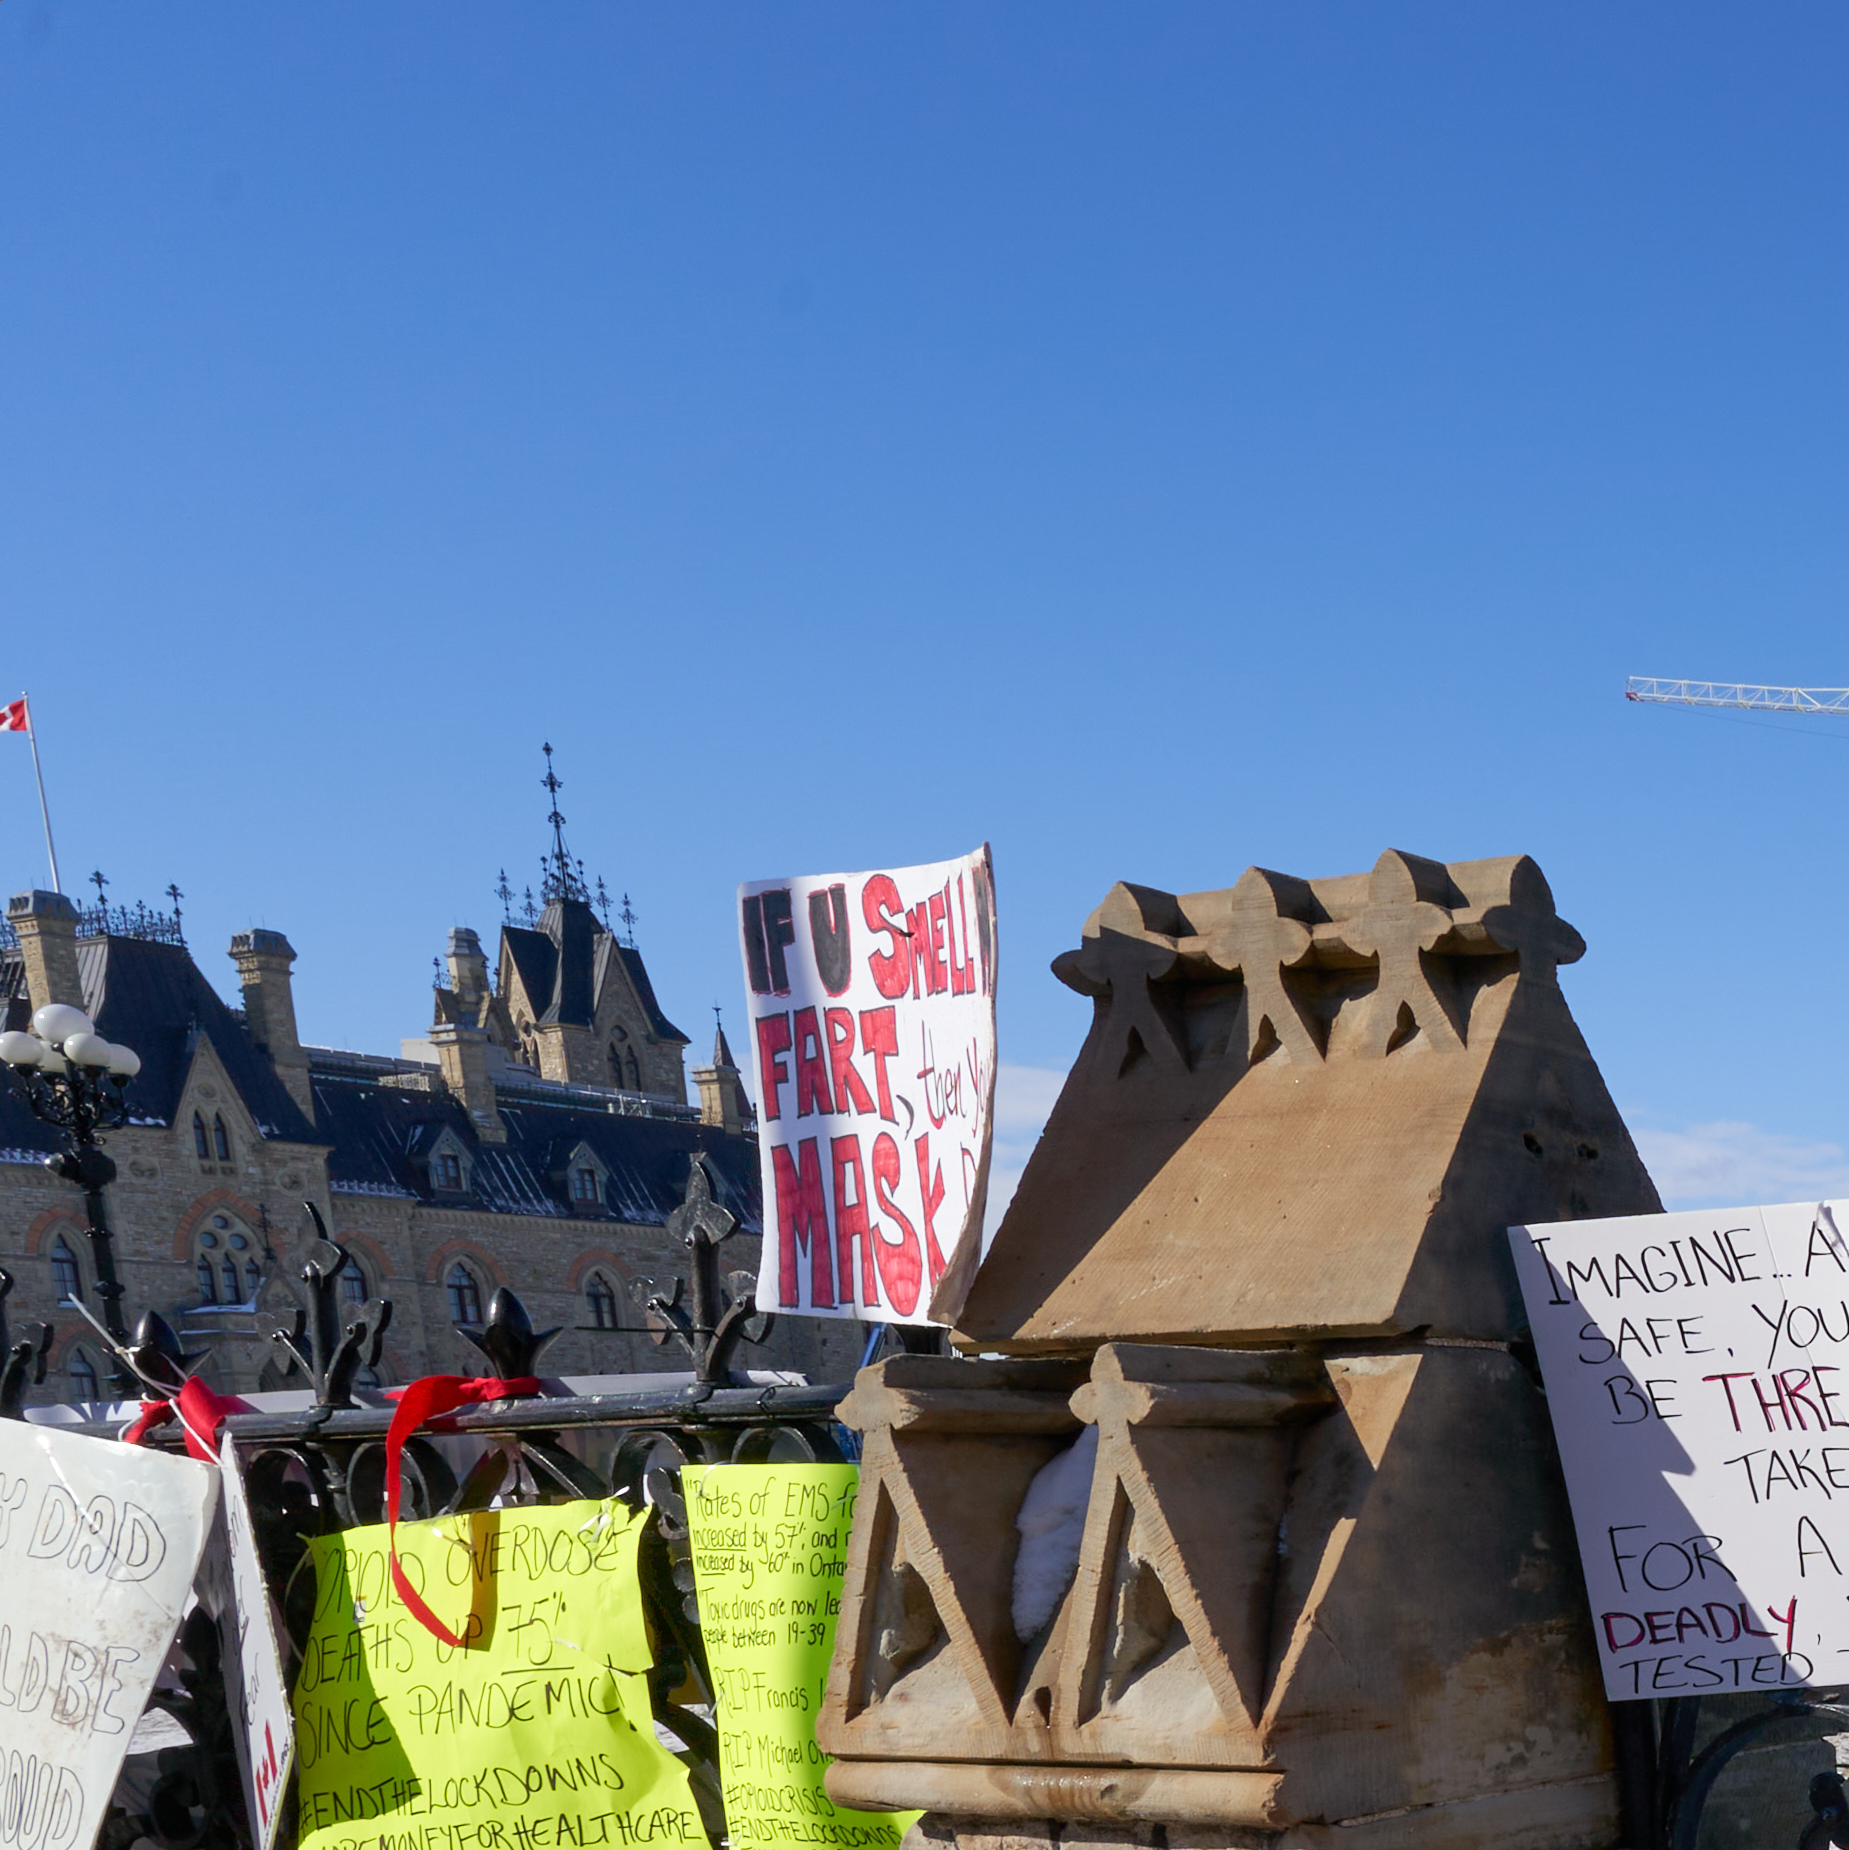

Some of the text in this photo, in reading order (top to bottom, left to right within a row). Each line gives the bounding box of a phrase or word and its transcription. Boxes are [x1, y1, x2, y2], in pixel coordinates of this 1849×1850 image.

[742, 888, 796, 997] IF
[808, 883, 852, 997] U
[862, 874, 975, 1001] SMELL
[756, 1005, 915, 1140] FART,
[771, 1131, 949, 1316] MASK
[1805, 1220, 1847, 1277] A
[1604, 1374, 1683, 1425] BE
[750, 1476, 831, 1521] of EMS
[27, 1484, 167, 1582] DAD
[446, 1523, 632, 1587] OVERDOSE
[691, 1521, 839, 1565] increased by and
[1607, 1524, 1738, 1593] FOR
[1798, 1514, 1843, 1579] A
[738, 1556, 756, 1590] by
[792, 1553, 807, 1576] in
[731, 1593, 818, 1622] drugs are now
[732, 1622, 826, 1650] between 19-39
[301, 1617, 414, 1694] DEATHS
[501, 1591, 567, 1665] 75%
[1619, 1651, 1815, 1694] TESTED
[301, 1653, 638, 1770] SINCE PANDEMIC!
[298, 1753, 625, 1833] #ENDTHELOCKDOWNS
